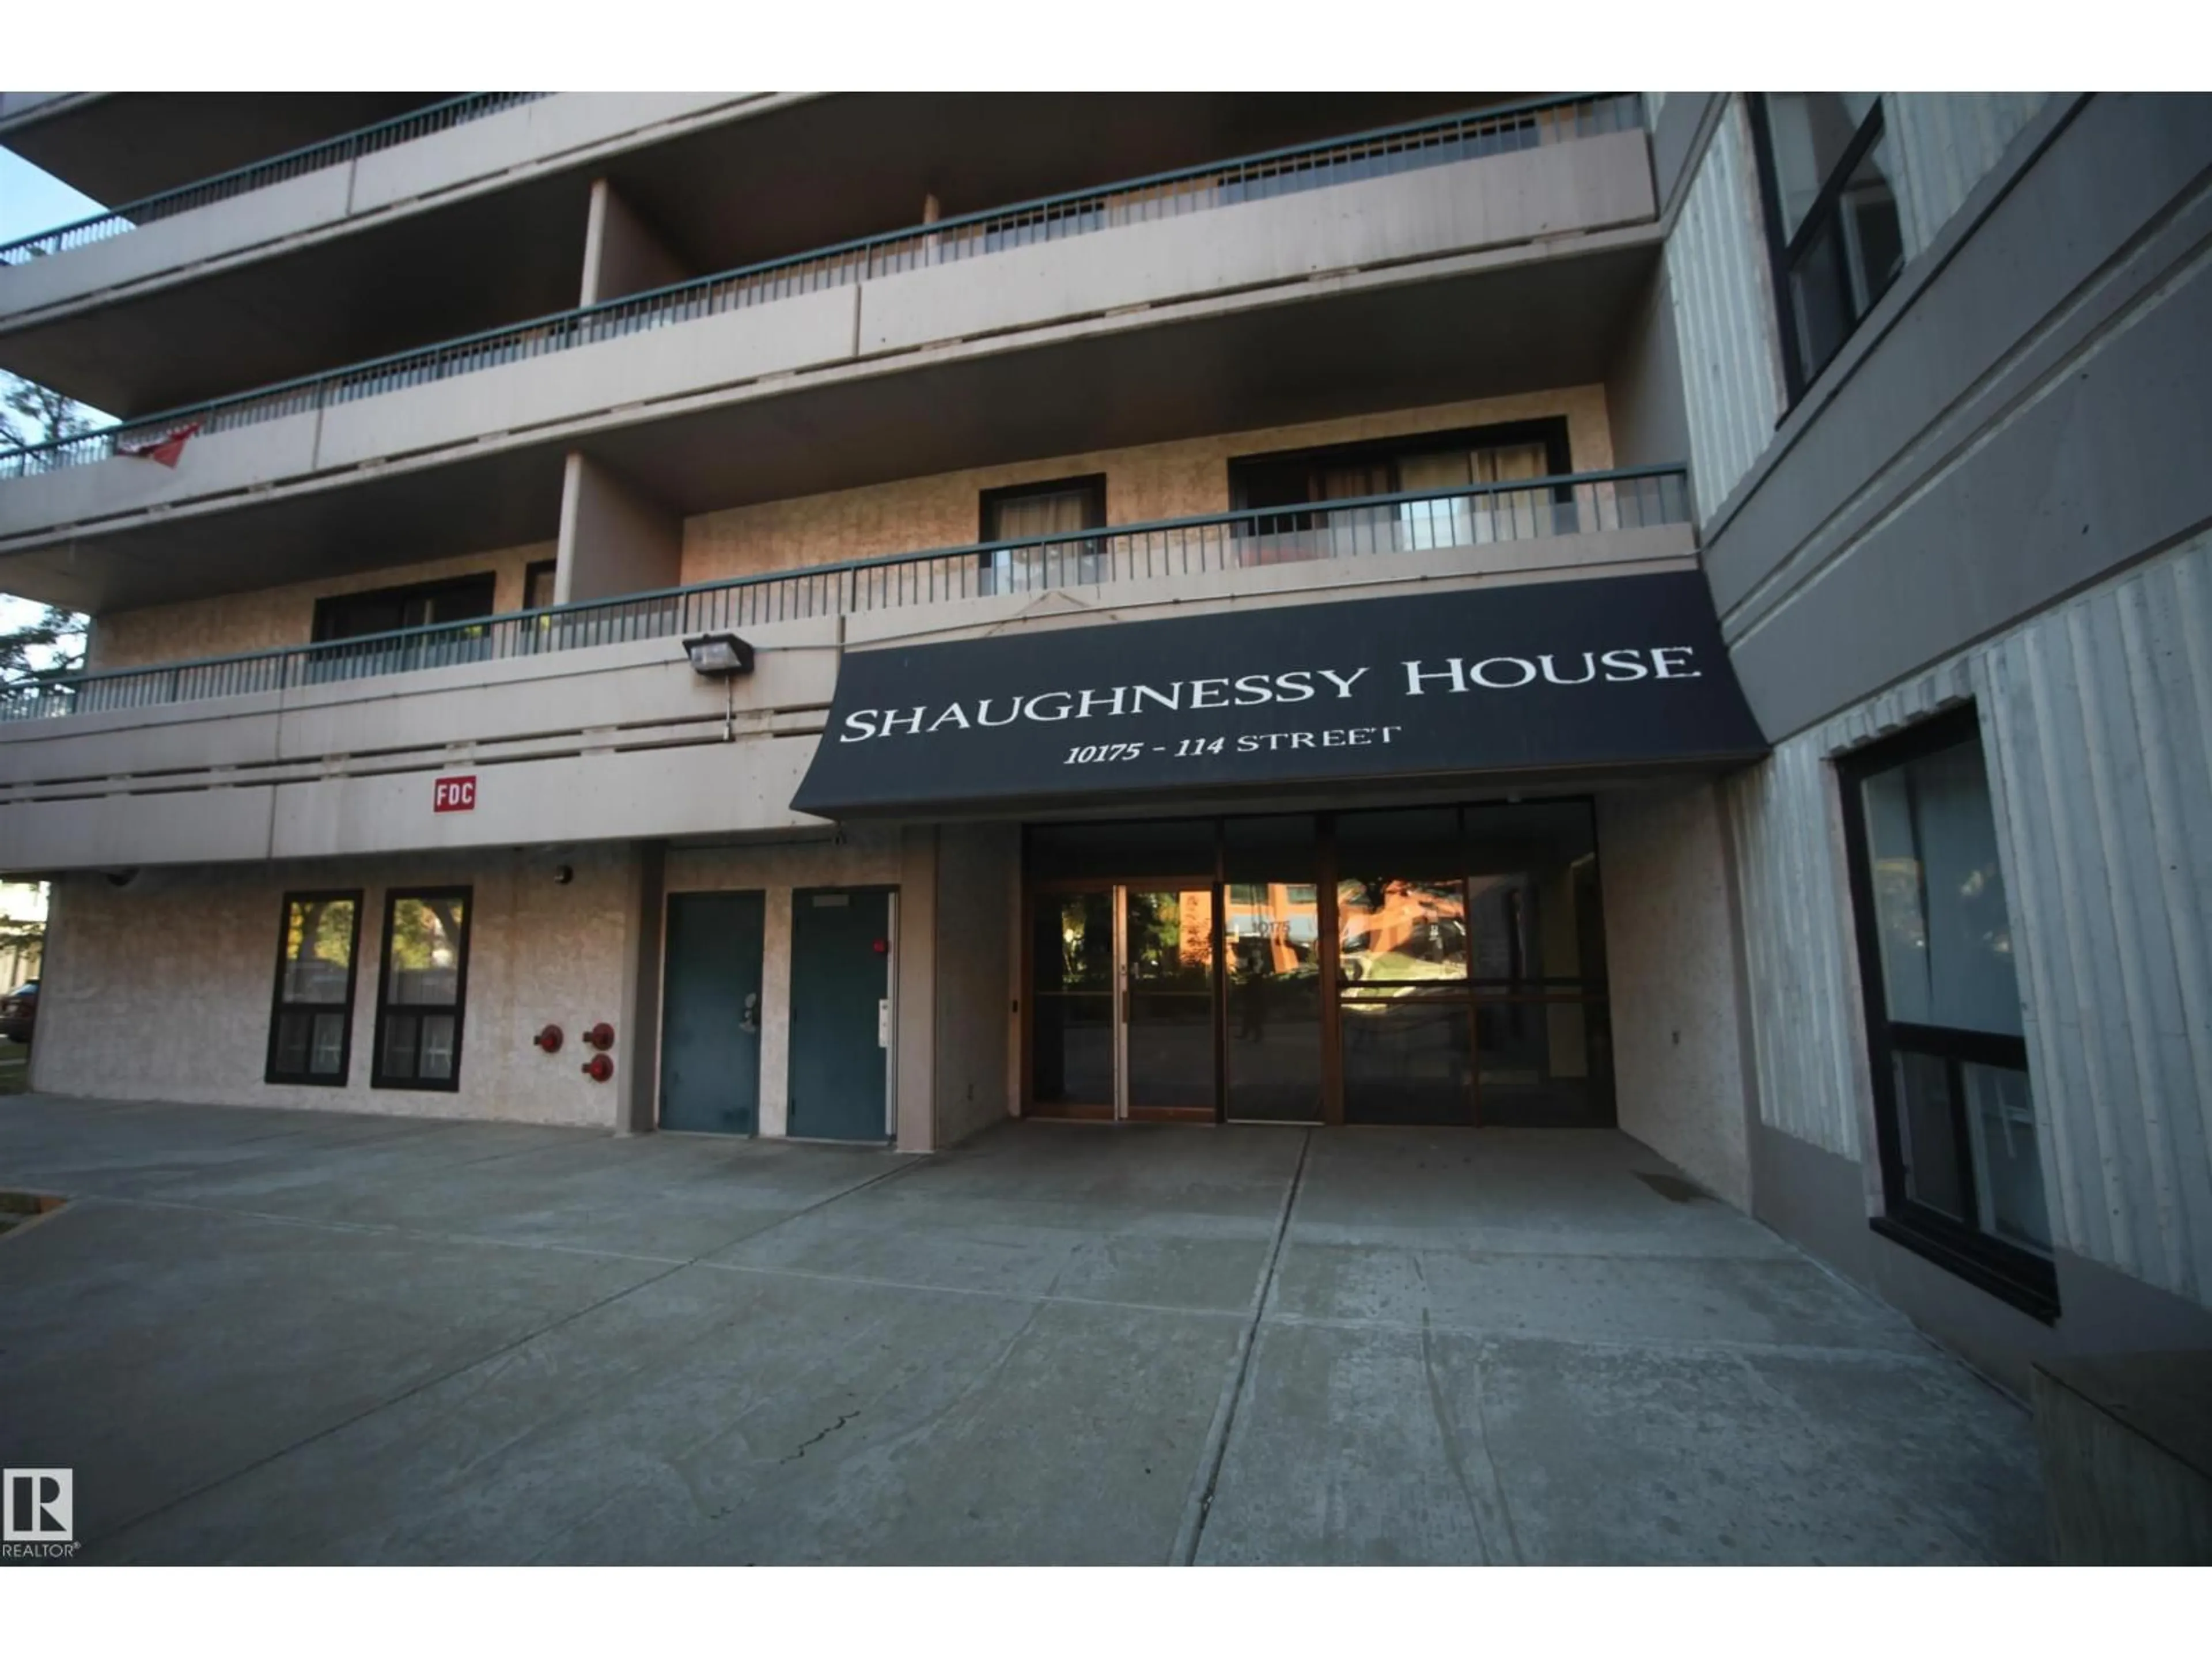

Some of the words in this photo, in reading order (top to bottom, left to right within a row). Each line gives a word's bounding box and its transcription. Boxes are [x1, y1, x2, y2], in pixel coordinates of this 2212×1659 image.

[839, 667, 1369, 743] SHAUGHNESSY
[1401, 646, 1702, 696] HOUSE
[1063, 742, 1145, 764] 10175
[1175, 737, 1225, 757] 114
[1237, 726, 1402, 752] STREET
[437, 783, 474, 806] FDC
